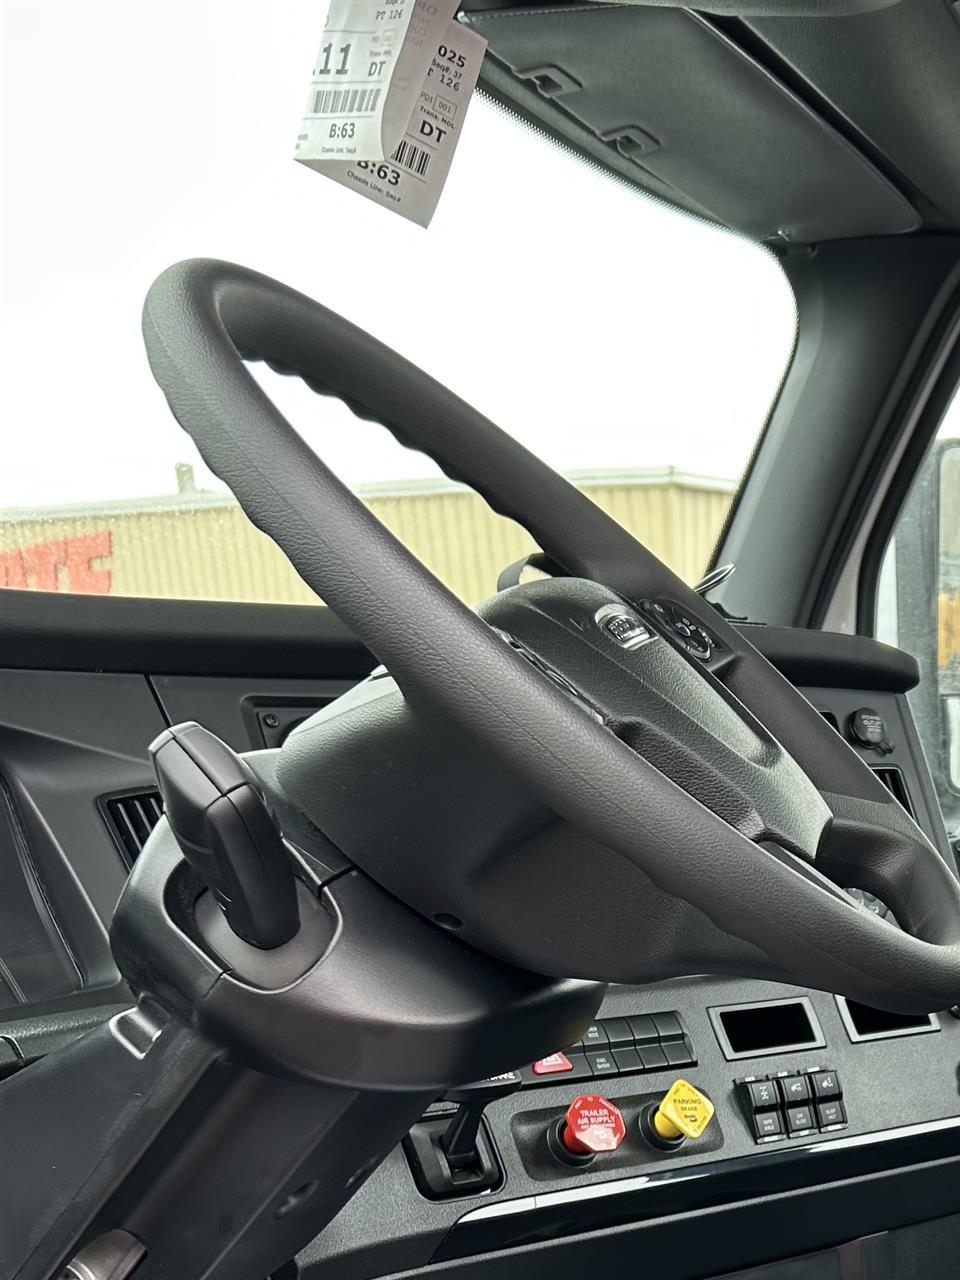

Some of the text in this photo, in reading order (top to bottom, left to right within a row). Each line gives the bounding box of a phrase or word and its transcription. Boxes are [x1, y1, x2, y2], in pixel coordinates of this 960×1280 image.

[438, 45, 466, 68] 025
[368, 61, 386, 76] DT
[440, 74, 460, 91] 126
[329, 122, 355, 138] B:63
[420, 120, 446, 143] DT
[580, 1108, 609, 1117] TRAILER
[590, 1115, 615, 1124] SUPPLY
